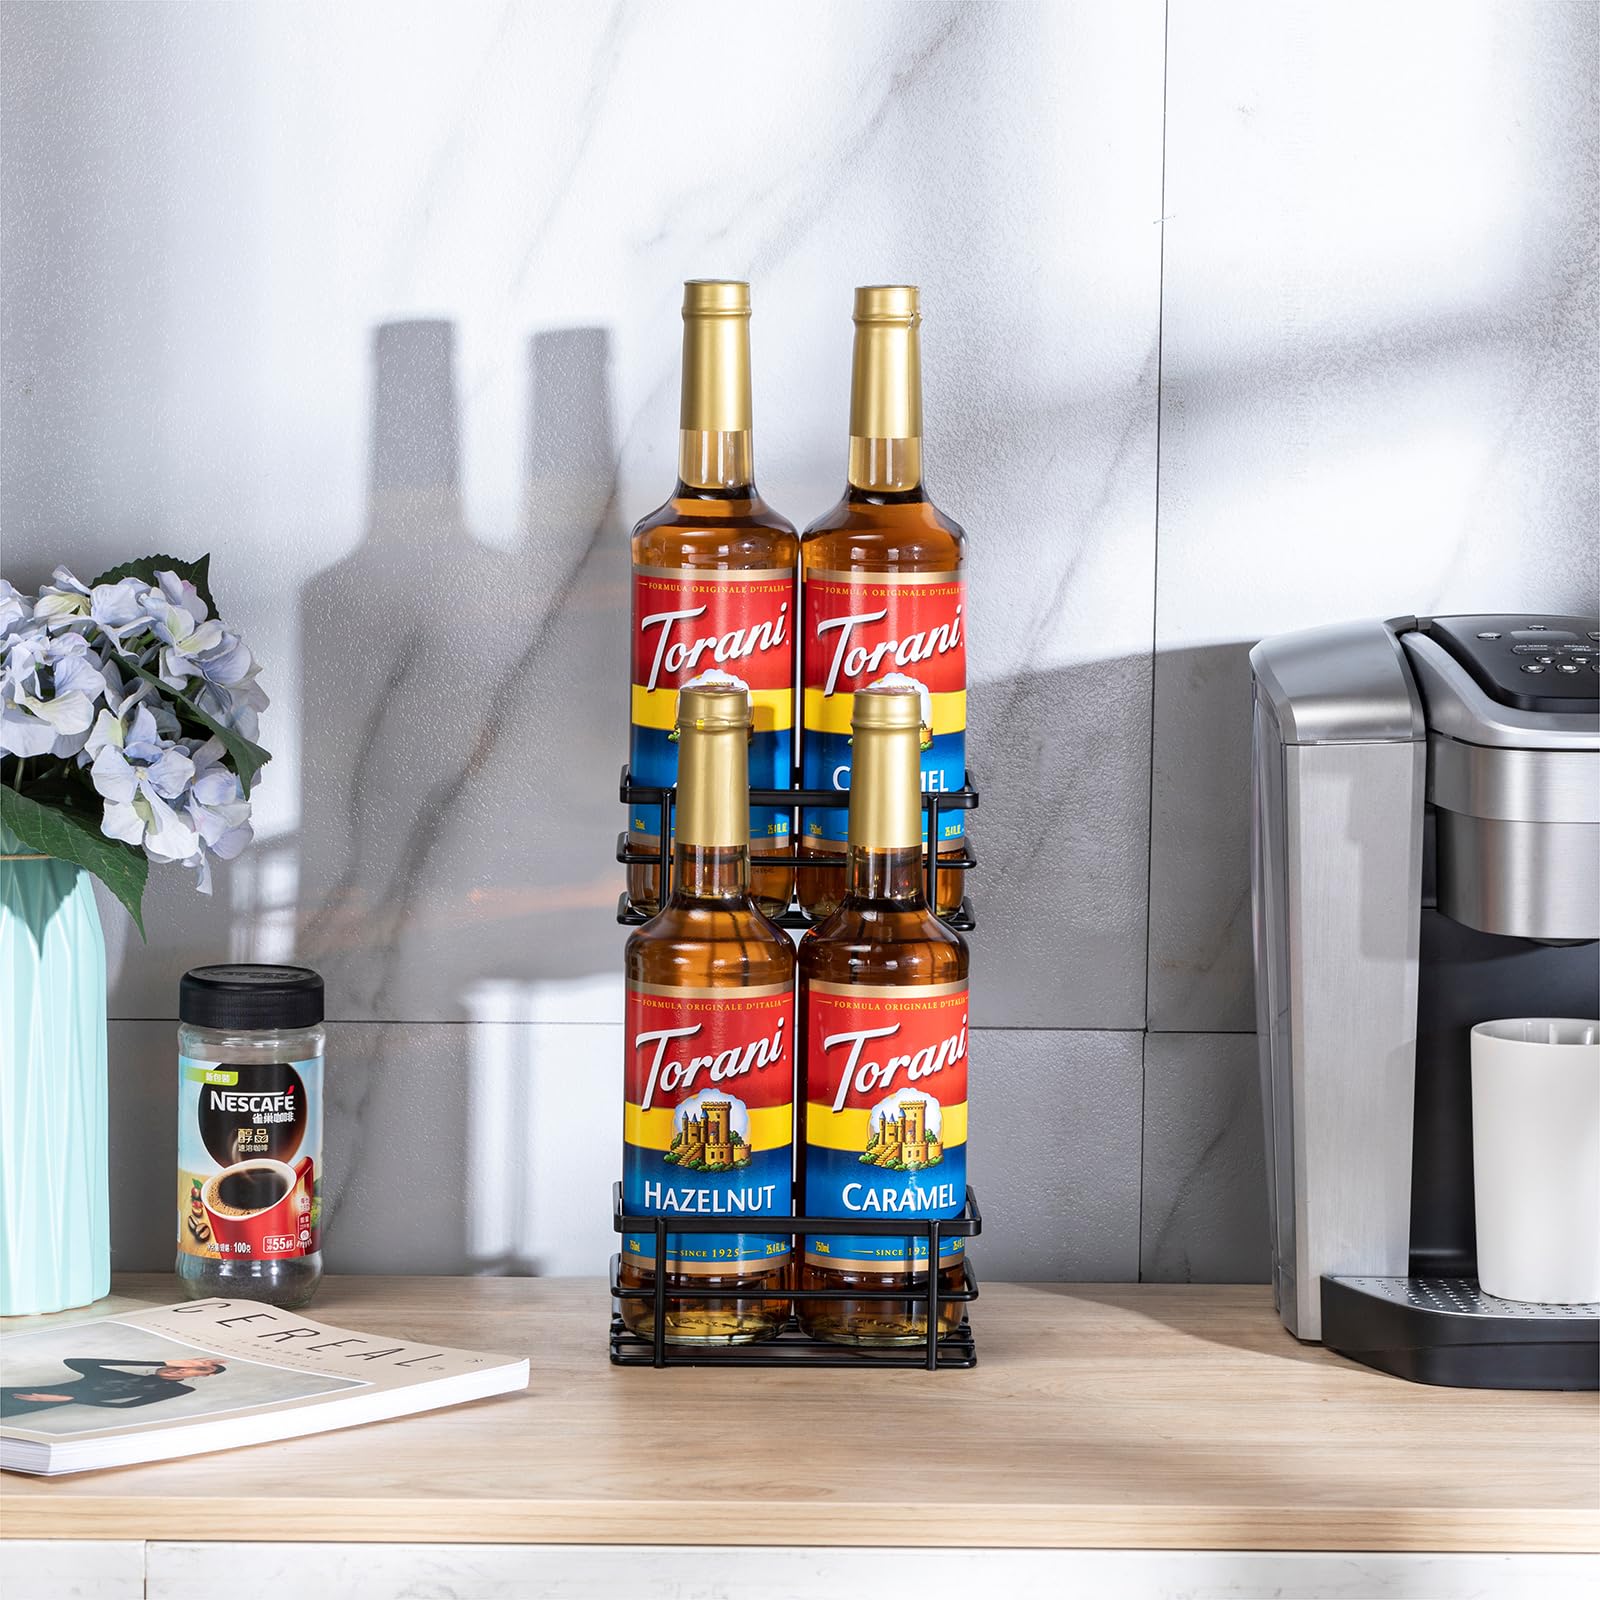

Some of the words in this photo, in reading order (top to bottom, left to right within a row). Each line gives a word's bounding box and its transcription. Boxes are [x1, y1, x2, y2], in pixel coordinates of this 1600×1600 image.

[648, 582, 687, 592] FORMULA
[691, 585, 746, 593] ORIGINALE
[750, 585, 785, 593] D'ITALIA
[825, 586, 867, 596] FORMULA
[871, 589, 926, 597] ORIGINALE
[641, 601, 788, 693] Torani
[817, 604, 963, 698] Torani
[642, 999, 682, 1010] FORMULA
[686, 1003, 743, 1011] ORIGINALE
[746, 1000, 782, 1010] D'ITALIA
[834, 1000, 880, 1010] FORMULA
[885, 1002, 938, 1011] ORIGINALE
[635, 1016, 785, 1111] Torani
[824, 1013, 967, 1113] Torani
[210, 1084, 296, 1113] NESCAFÉ
[644, 1180, 776, 1213] HAZELNUT
[842, 1182, 957, 1212] CARAMEL
[712, 1247, 740, 1258] 1925
[908, 1246, 930, 1256] 192
[172, 1302, 445, 1367] CEREAL
